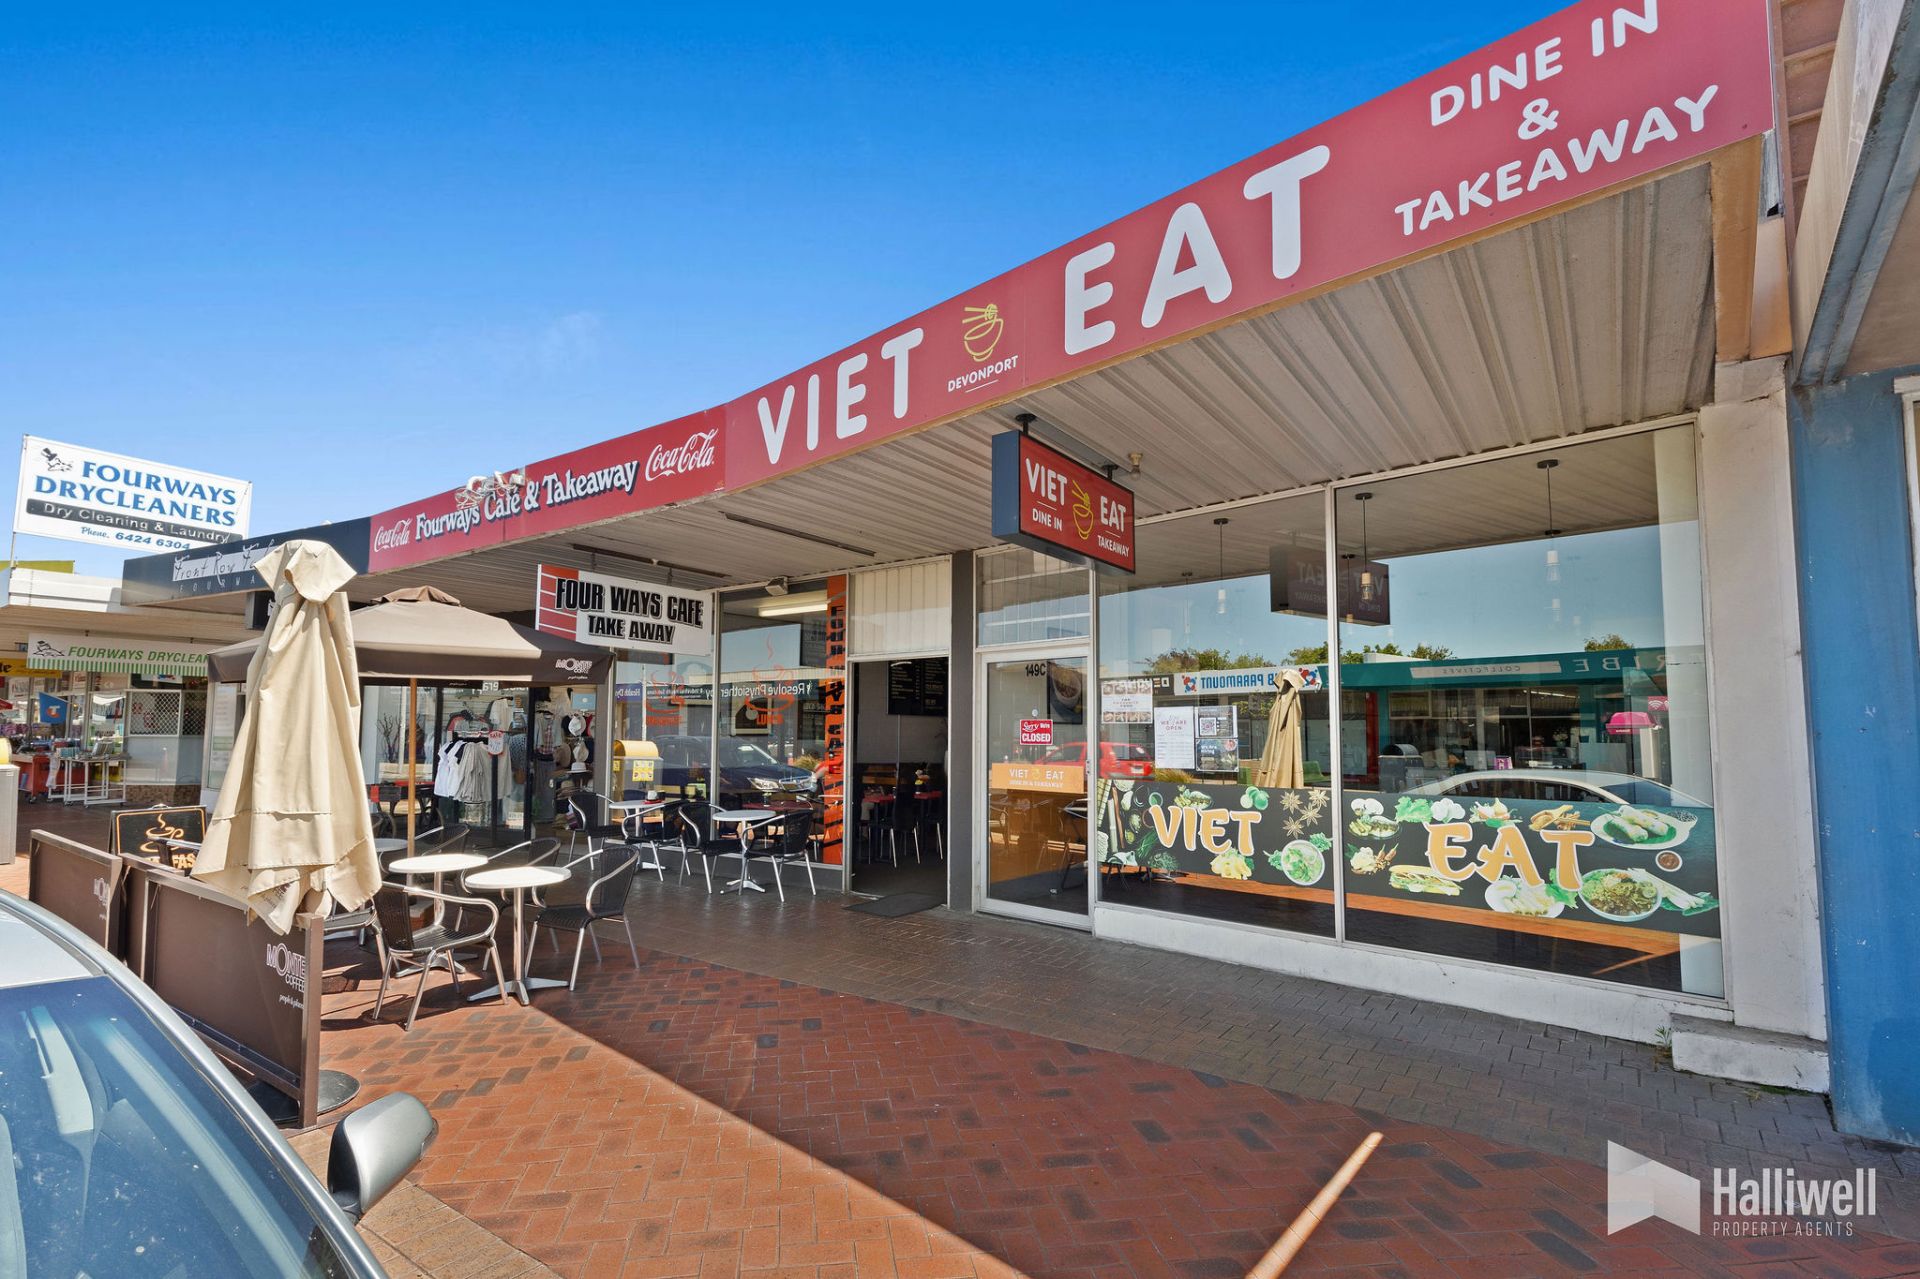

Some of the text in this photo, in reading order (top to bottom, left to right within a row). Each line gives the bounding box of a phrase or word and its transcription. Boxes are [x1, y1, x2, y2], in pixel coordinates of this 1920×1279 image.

[1430, 0, 1659, 127] DINE IN
[1517, 98, 1560, 140] &
[1394, 84, 1719, 237] TAKEAWAY
[1064, 145, 1331, 355] EAT
[947, 355, 1019, 392] DEVONPORT
[757, 327, 924, 465] VIET
[645, 428, 719, 482] Coca-Cola
[34, 475, 236, 527] DRYCLEANERS
[81, 460, 237, 505] FOURWAYS
[415, 505, 481, 541] Fourways
[523, 480, 539, 511] &
[542, 460, 639, 506] Takeaway
[1025, 457, 1068, 506] VIET
[43, 502, 230, 544] Dry Cleaning & Laundry
[1032, 508, 1063, 532] DINE IN
[1100, 495, 1127, 533] EAT
[115, 531, 152, 545] 6424
[155, 538, 190, 550] 6304
[1097, 534, 1130, 558] TAKEAWAY
[555, 577, 704, 629] FOUR WAYS CAFE
[587, 614, 676, 644] TAKE AWAY
[68, 646, 143, 661] FOURWAYS
[1025, 663, 1046, 677] 149C
[1022, 721, 1039, 733] Sorry
[1022, 733, 1051, 742] CLOSED
[1009, 768, 1064, 780] VIET EAT
[1149, 804, 1262, 857] VIET
[1423, 822, 1595, 892] EAT
[266, 942, 306, 979] MONTE
